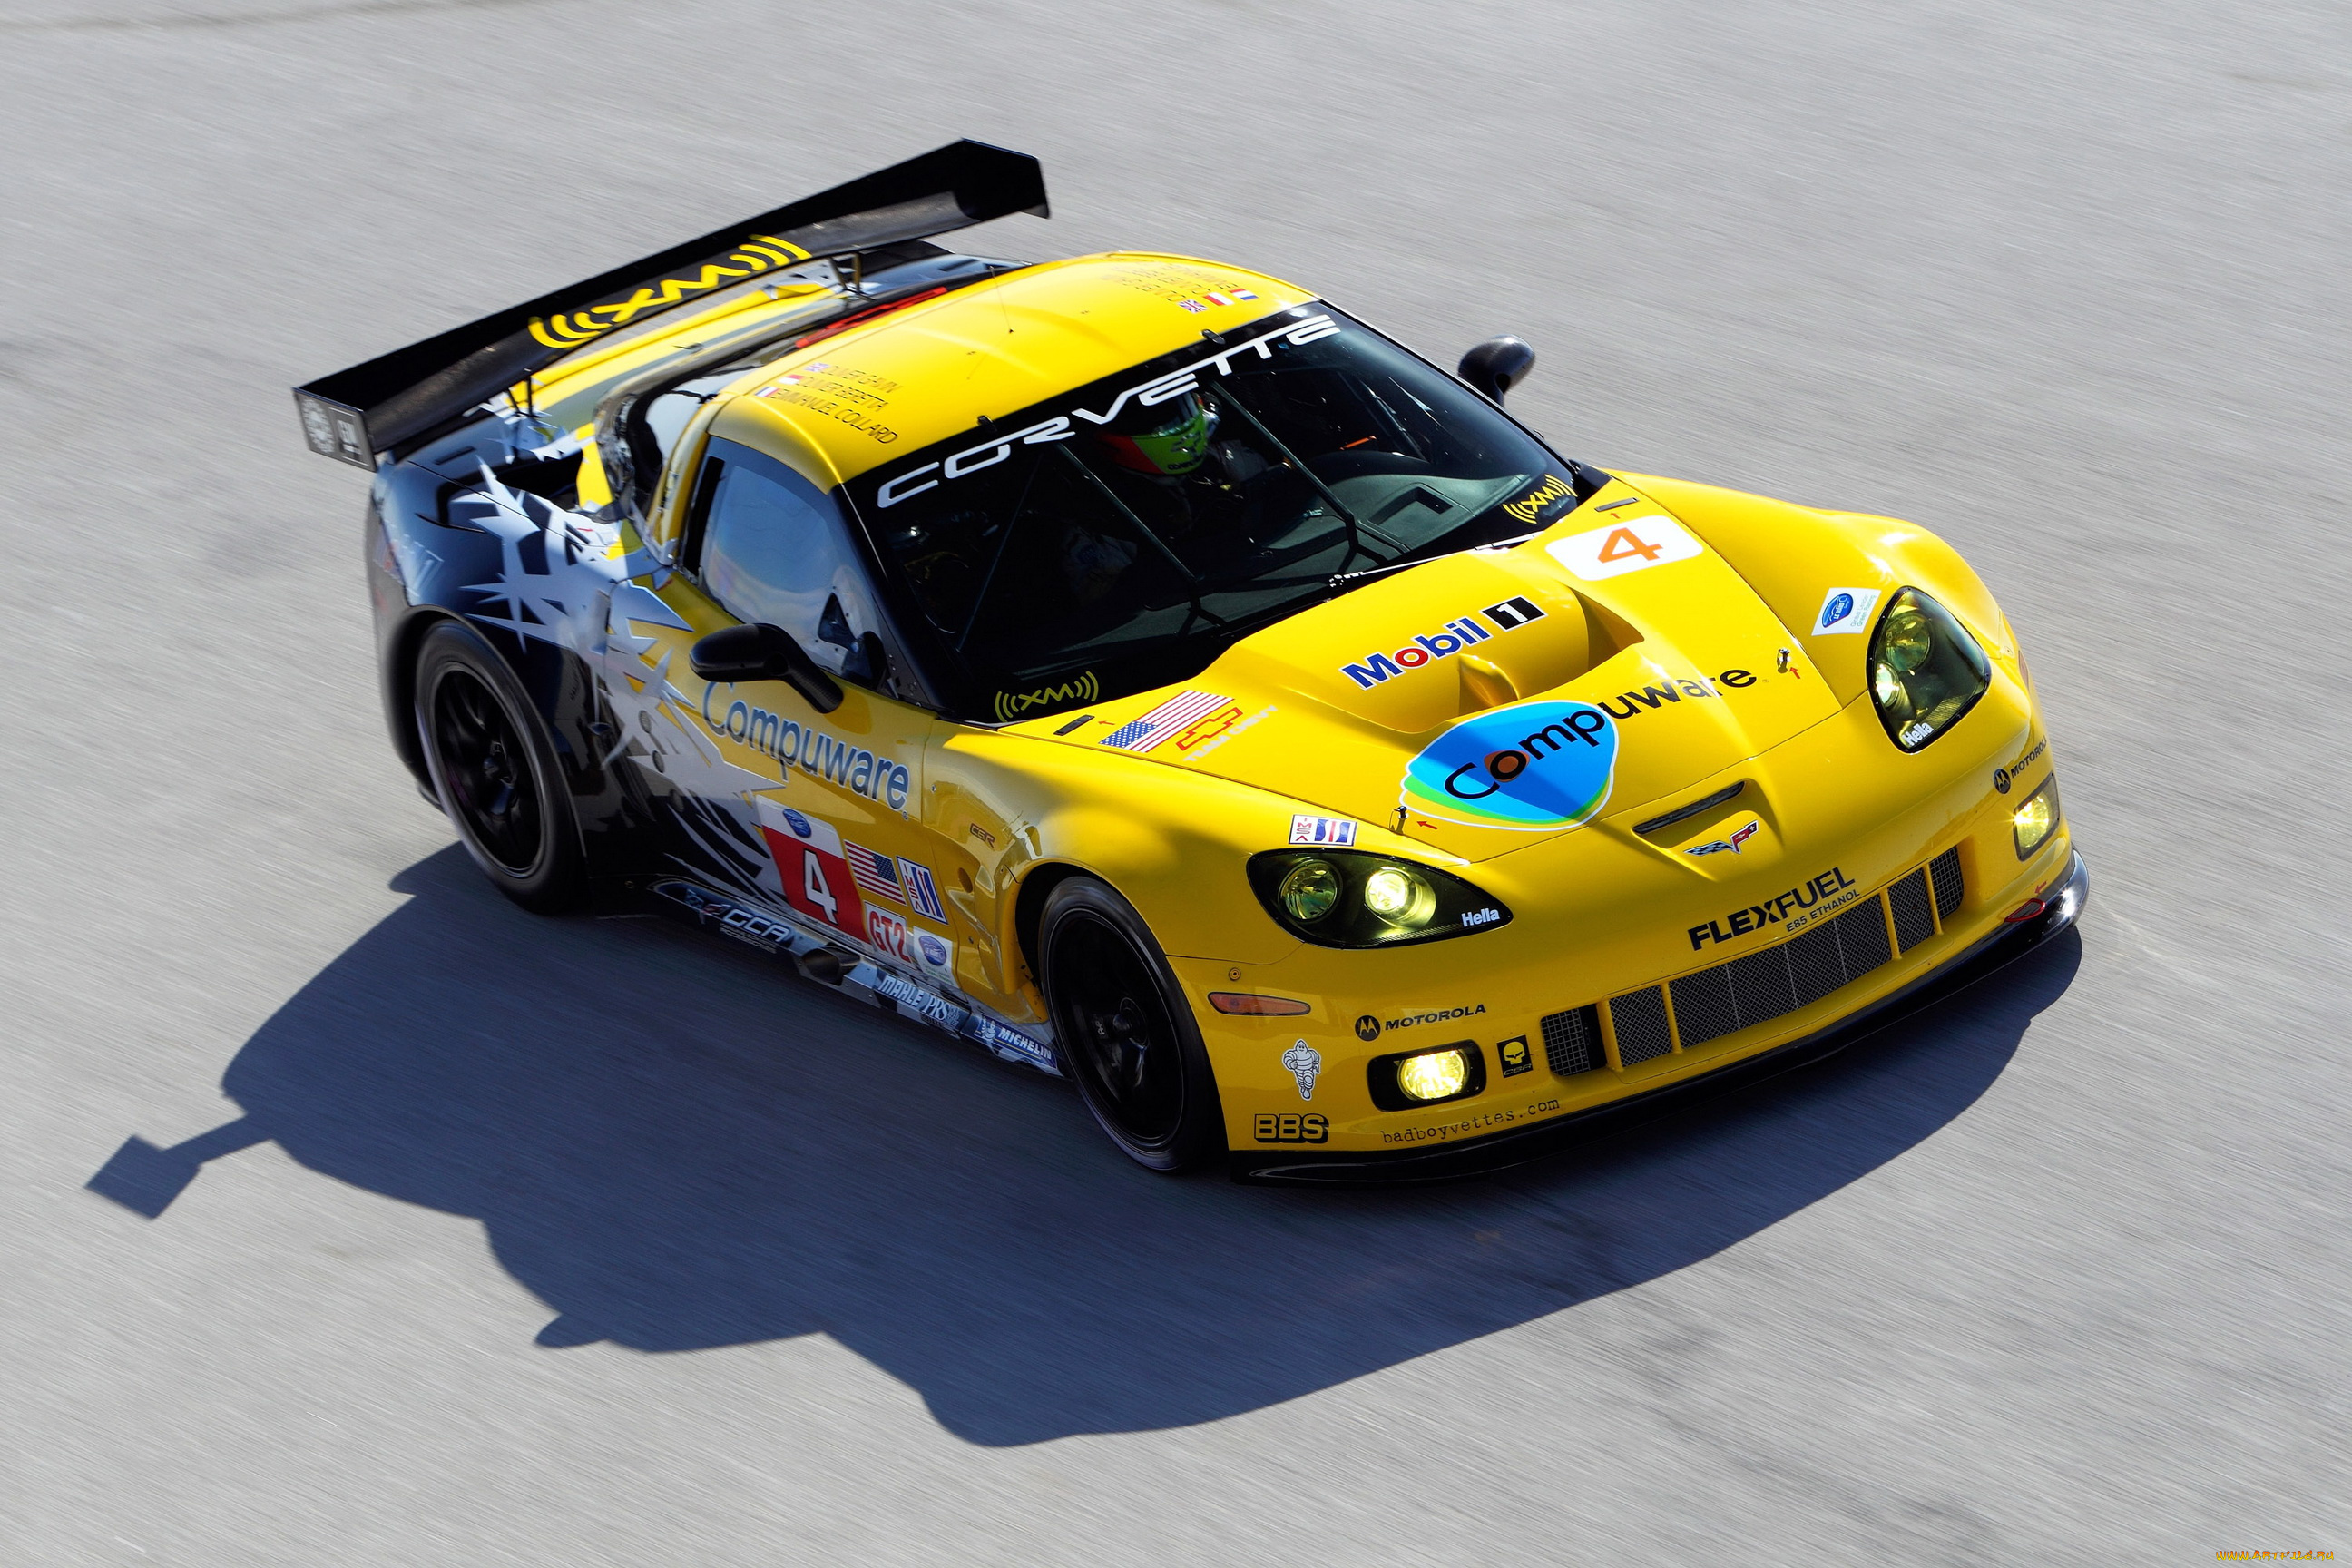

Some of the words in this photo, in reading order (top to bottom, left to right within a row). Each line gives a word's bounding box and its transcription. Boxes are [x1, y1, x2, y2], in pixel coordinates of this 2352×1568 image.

[834, 408, 898, 445] COLLARD
[877, 313, 1342, 509] CORVETTE
[1596, 526, 1664, 564] 4
[1339, 616, 1494, 690] Mobil
[702, 681, 910, 811] Compuware
[1444, 669, 1758, 800] Compuware
[1901, 722, 1935, 746] Hella
[803, 848, 839, 926] 4
[1687, 867, 1857, 952] FLEXFUEL
[1786, 916, 1808, 933] E85
[1808, 887, 1861, 920] ETHANOL
[867, 910, 912, 964] GT2
[1461, 907, 1501, 927] Hella
[877, 975, 925, 1008] MAHLE
[921, 995, 952, 1021] PRS
[1384, 1003, 1487, 1032] MOTOROLA
[998, 1027, 1053, 1060] MICHELIN
[1254, 1112, 1330, 1144] BBS
[1380, 1098, 1561, 1144] badboyvettes.com
